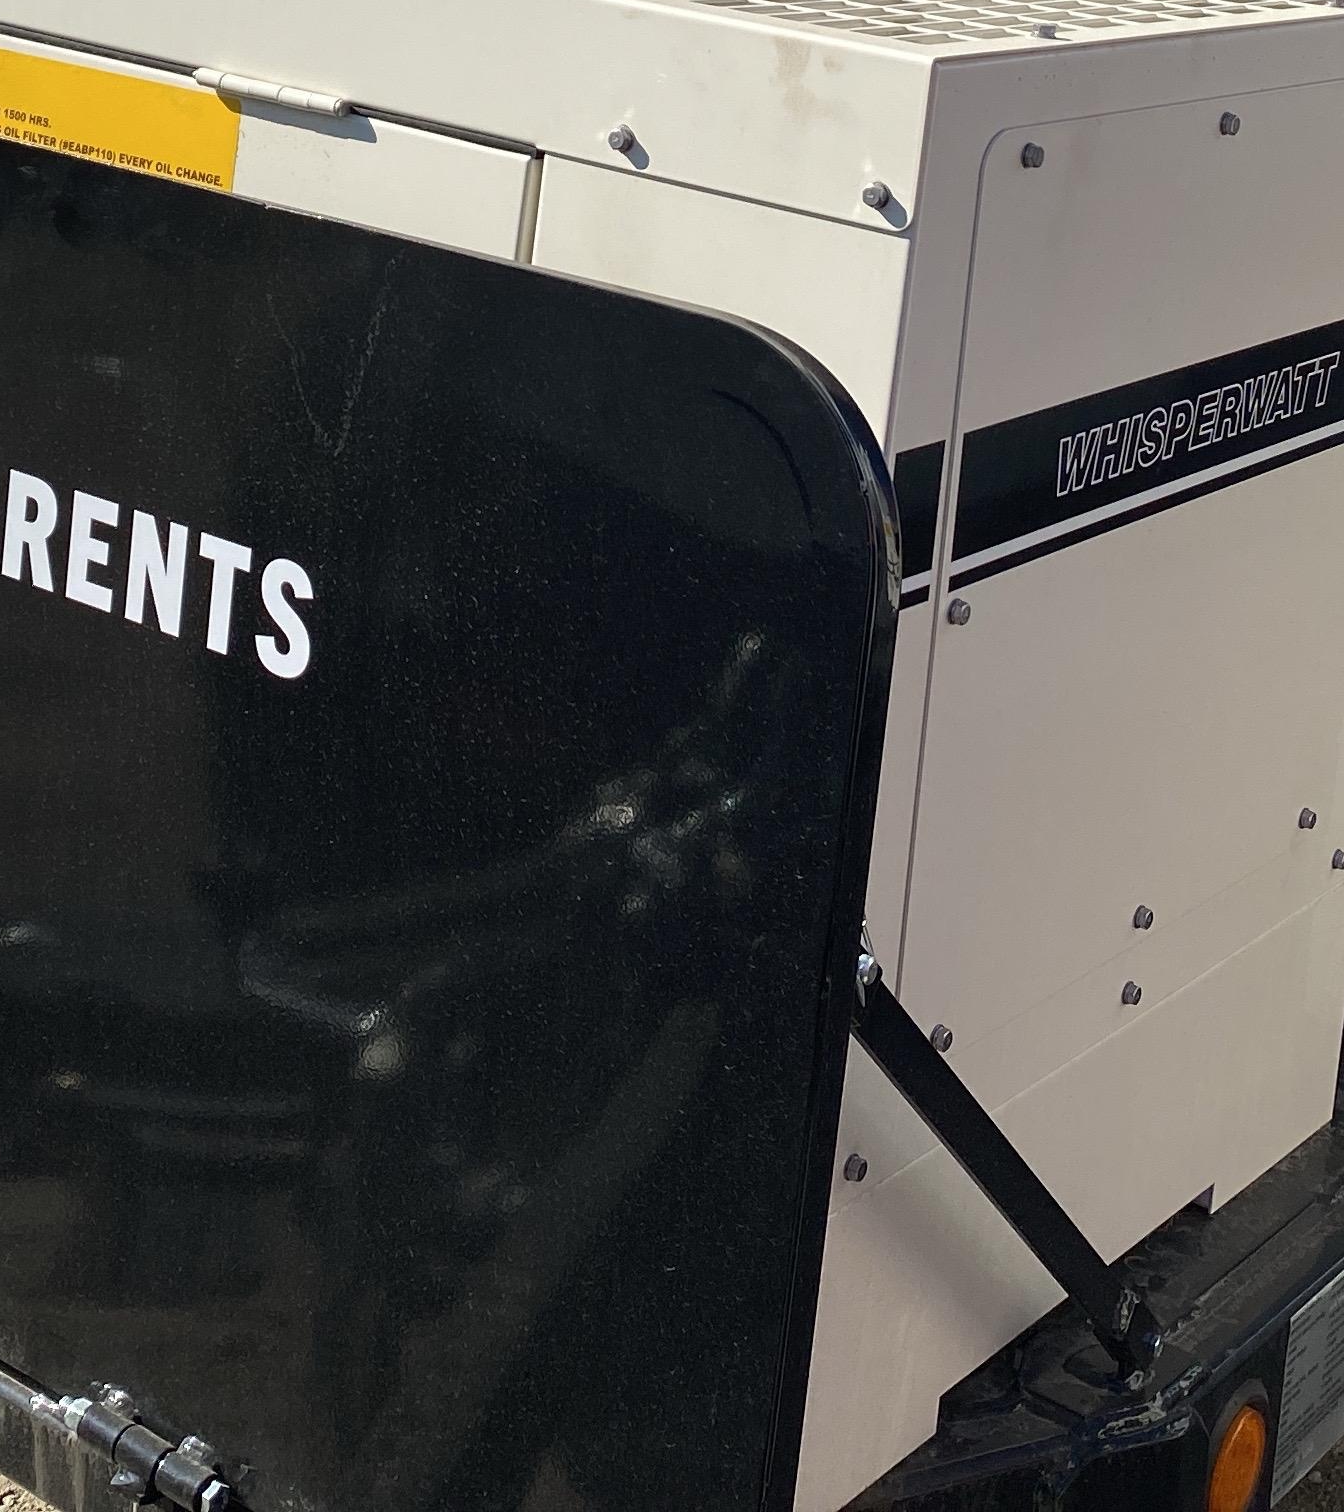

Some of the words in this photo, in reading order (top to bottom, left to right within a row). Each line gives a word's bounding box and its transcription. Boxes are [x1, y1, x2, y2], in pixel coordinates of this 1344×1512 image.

[4, 108, 27, 122] 1500
[29, 113, 52, 129] HRS.
[4, 126, 20, 139] OIL
[23, 130, 57, 149] FILTER
[119, 152, 154, 171] EVERY
[156, 161, 173, 176] OIL
[175, 166, 224, 187] CHANGE.
[1056, 351, 1342, 497] WHISPERWATT
